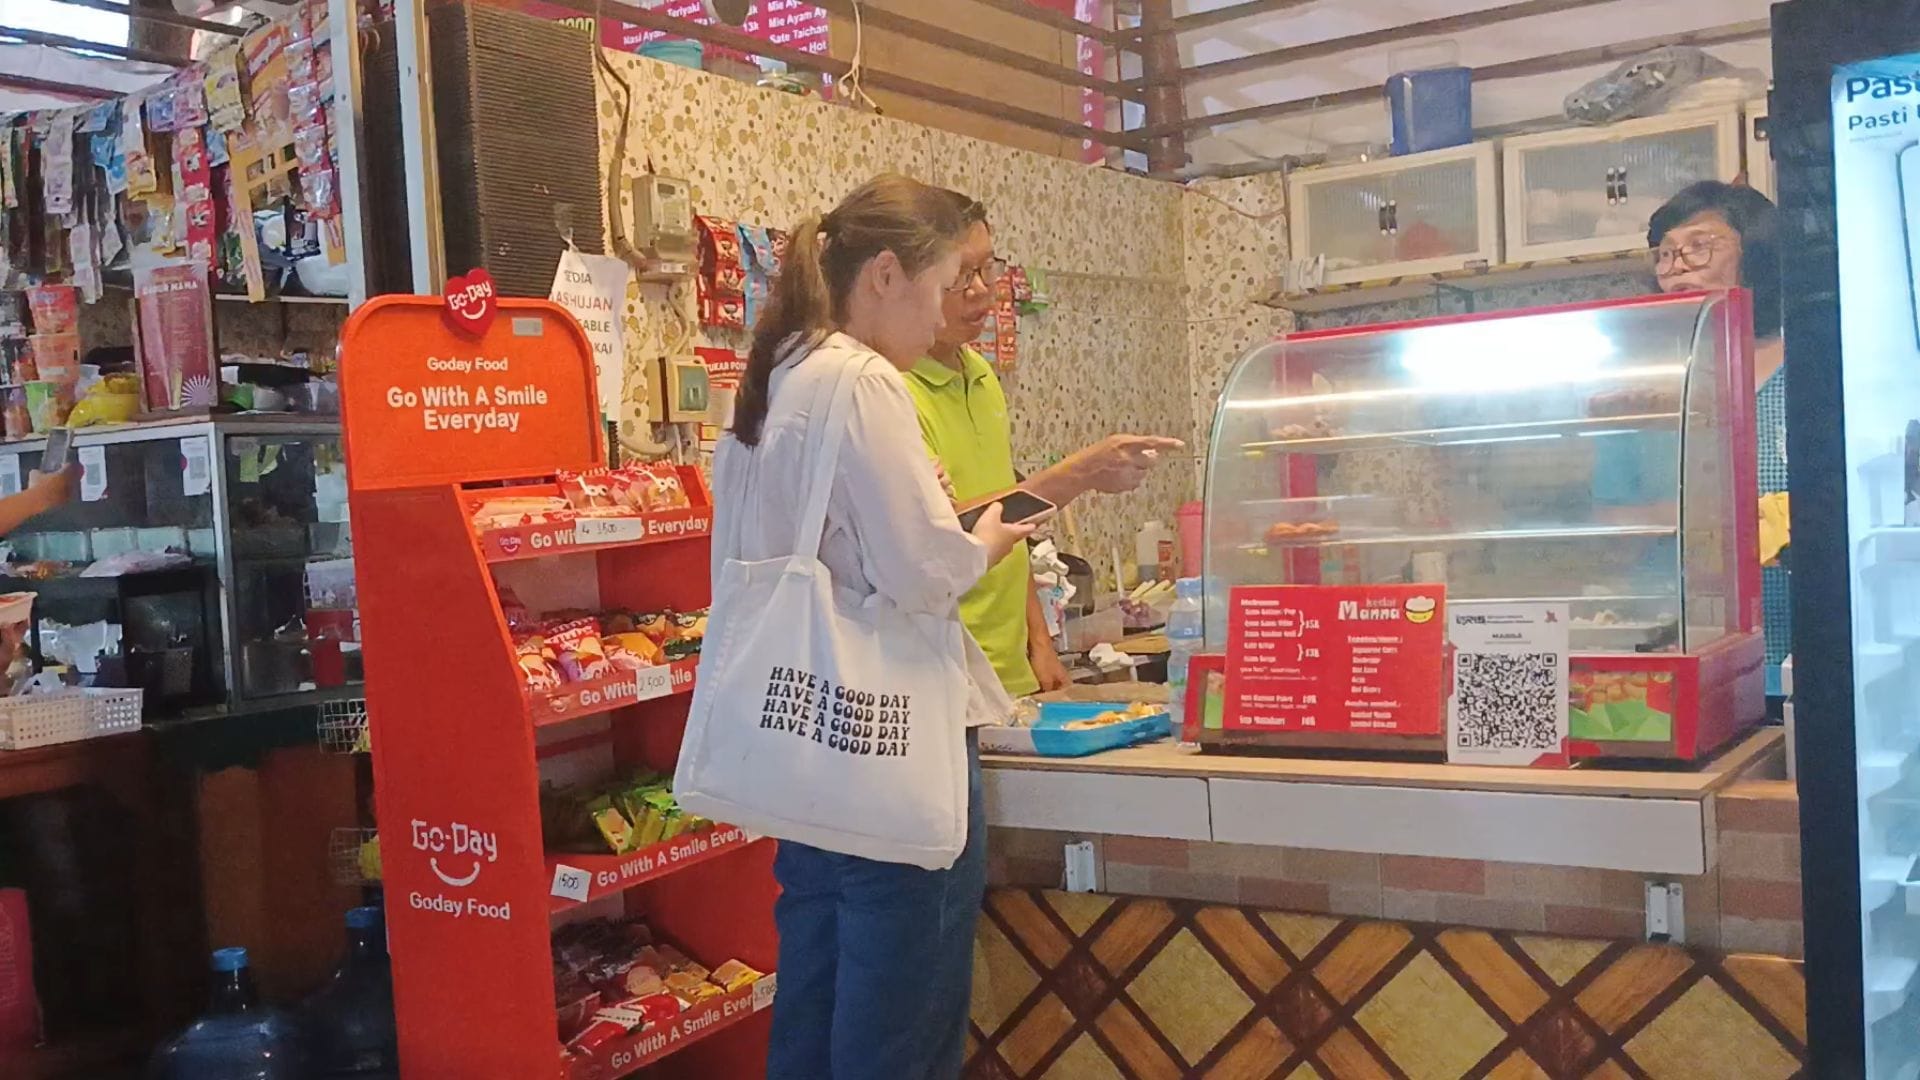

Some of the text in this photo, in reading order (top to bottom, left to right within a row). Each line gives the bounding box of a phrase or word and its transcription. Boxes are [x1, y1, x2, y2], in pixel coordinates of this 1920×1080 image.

[768, 17, 786, 28] Mie
[787, 11, 813, 25] Ayam
[792, 25, 829, 40] Taichan
[1849, 106, 1908, 131] Pasti
[426, 356, 509, 374] Goday Food
[386, 383, 548, 408] Go With A Smile
[423, 407, 520, 434] Everyday
[530, 532, 552, 549] Go
[648, 516, 709, 537] Everyday
[1337, 600, 1401, 621] Manna
[580, 690, 600, 706] Go
[604, 680, 637, 701] With
[770, 666, 911, 709] HAVE A GOOD DAY
[766, 682, 911, 725] HAVE A GOOD DAY
[762, 698, 911, 741] HAVE A GOOD DAY
[760, 714, 910, 757] HAVE A GOOD DAY
[411, 818, 498, 863] Go-Day
[597, 871, 618, 887] Go
[619, 857, 654, 879] With
[656, 850, 668, 867] A
[670, 838, 708, 862] Smile
[409, 891, 511, 920] Goday Food
[611, 1051, 632, 1069] Go
[633, 1036, 667, 1056] With
[669, 1025, 681, 1042] A
[683, 1008, 721, 1035] Smile
